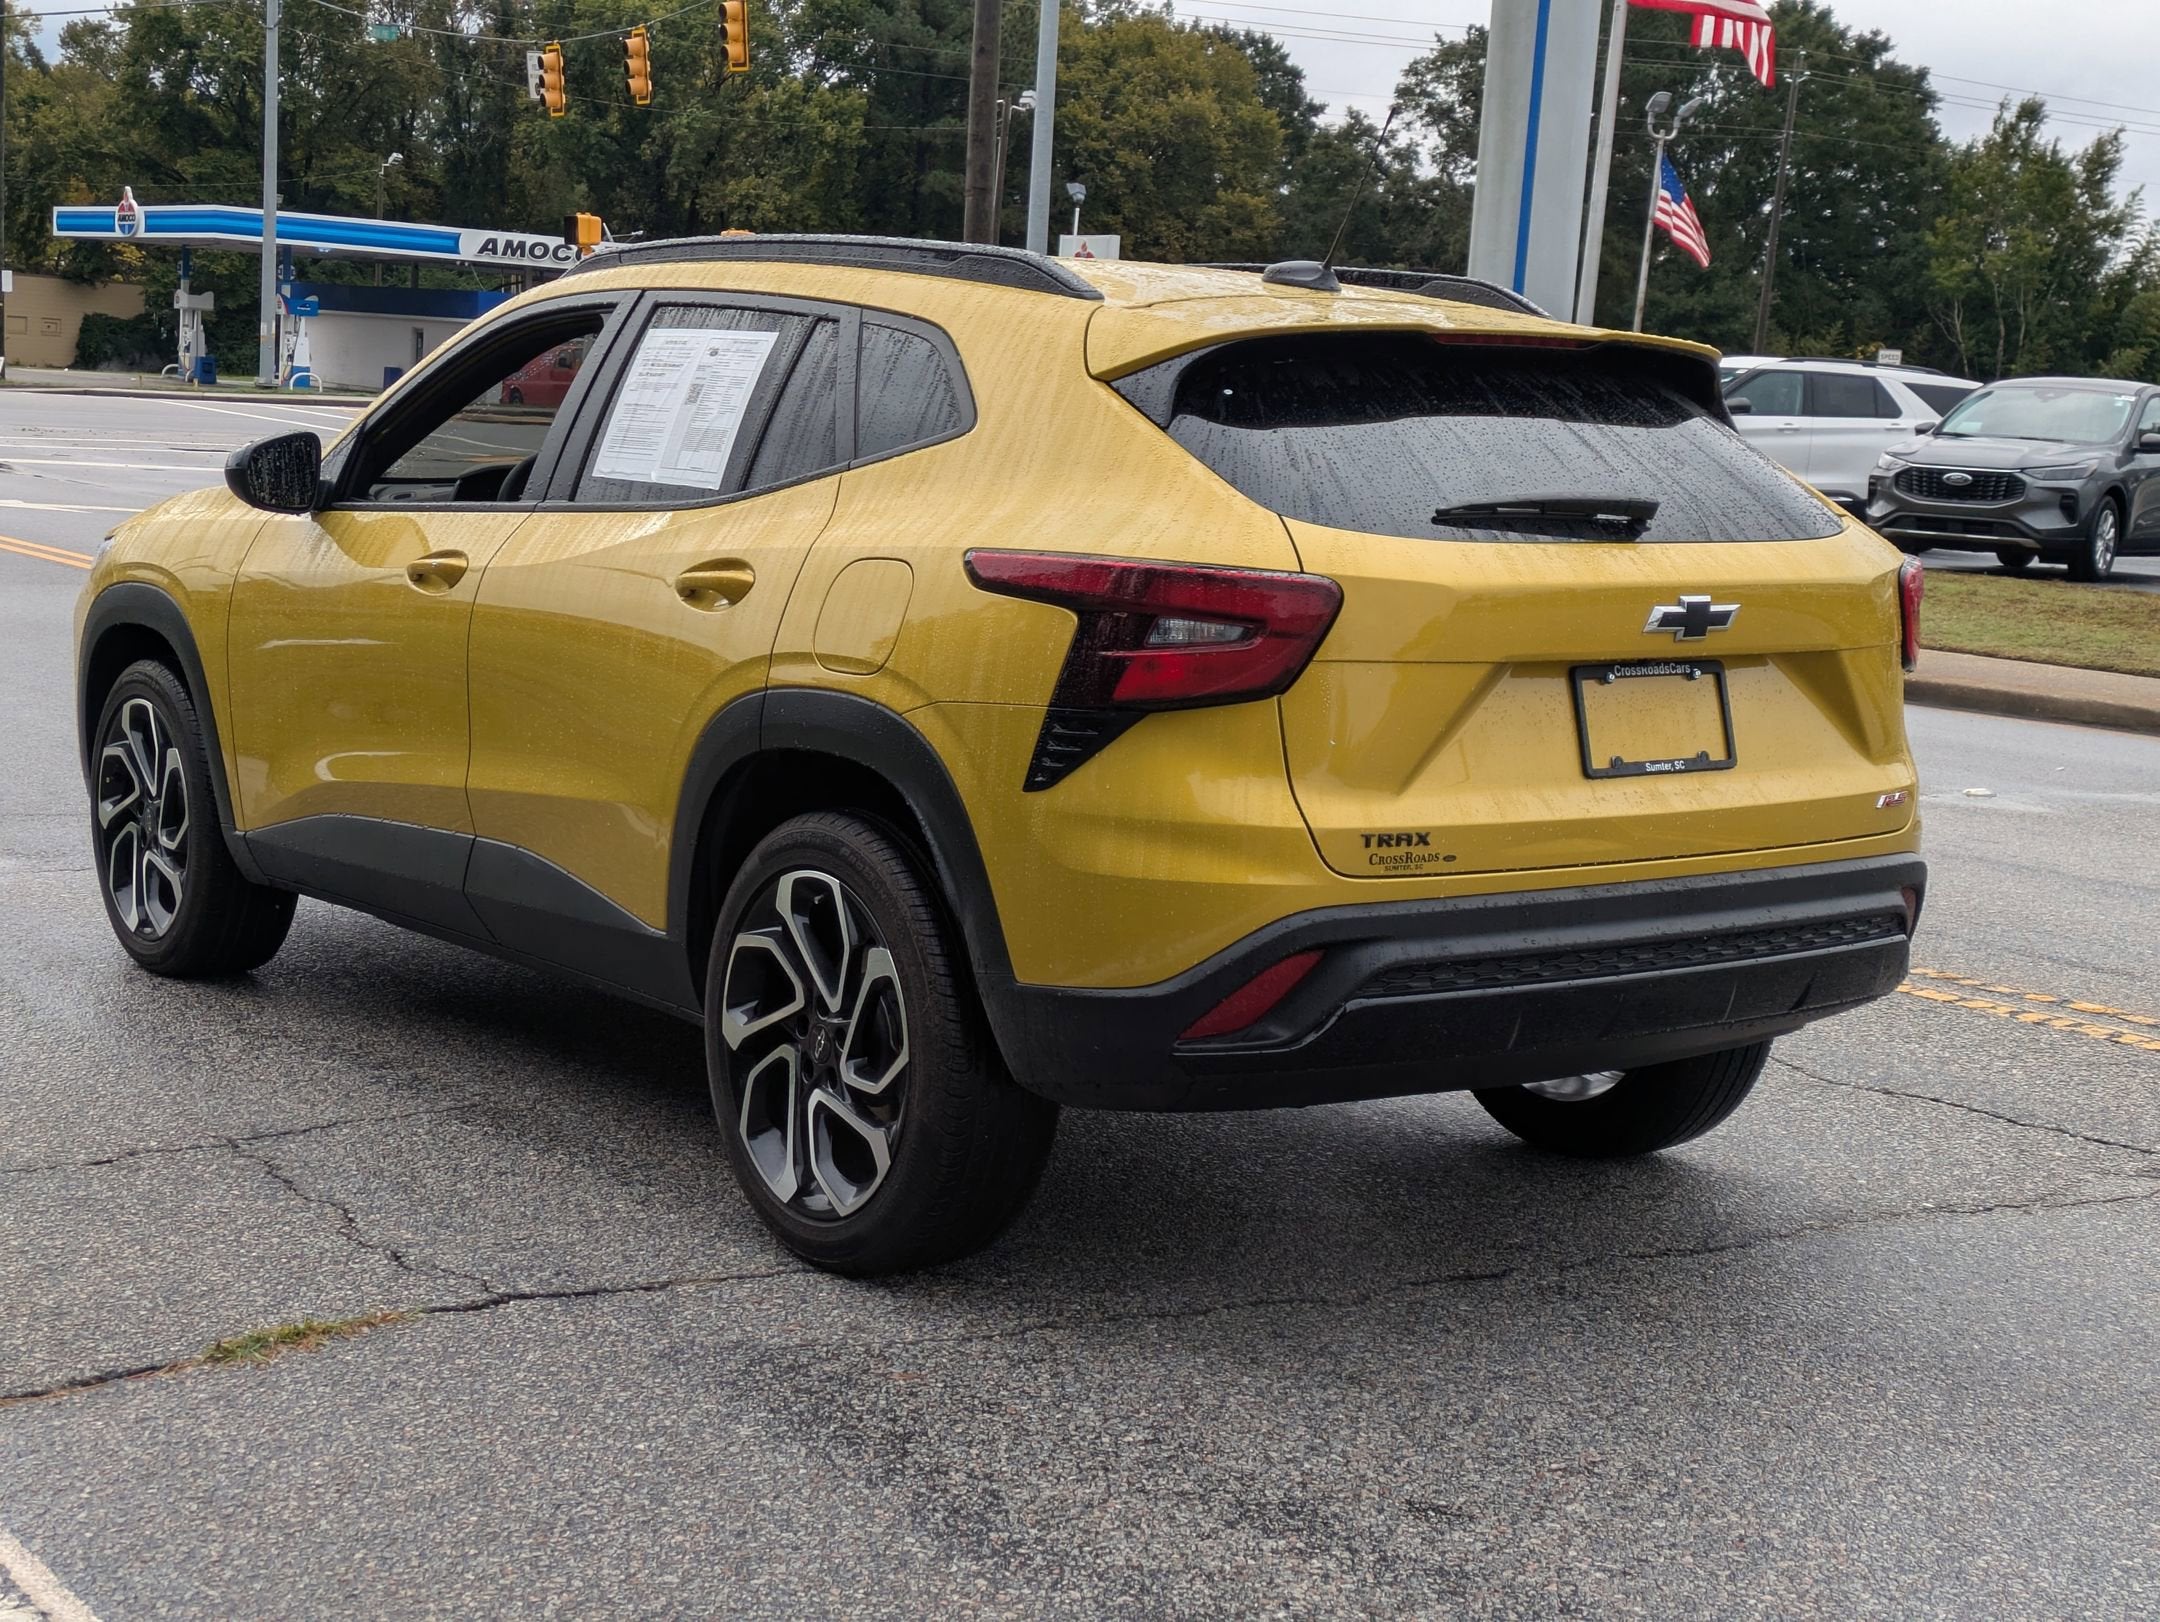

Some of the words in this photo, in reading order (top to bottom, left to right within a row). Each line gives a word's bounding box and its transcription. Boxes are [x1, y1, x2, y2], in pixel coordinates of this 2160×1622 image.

[1614, 663, 1691, 676] CrossRoadsCars
[1645, 762, 1674, 771] Sumter,
[1675, 760, 1686, 770] SC
[1360, 832, 1431, 848] TRAX
